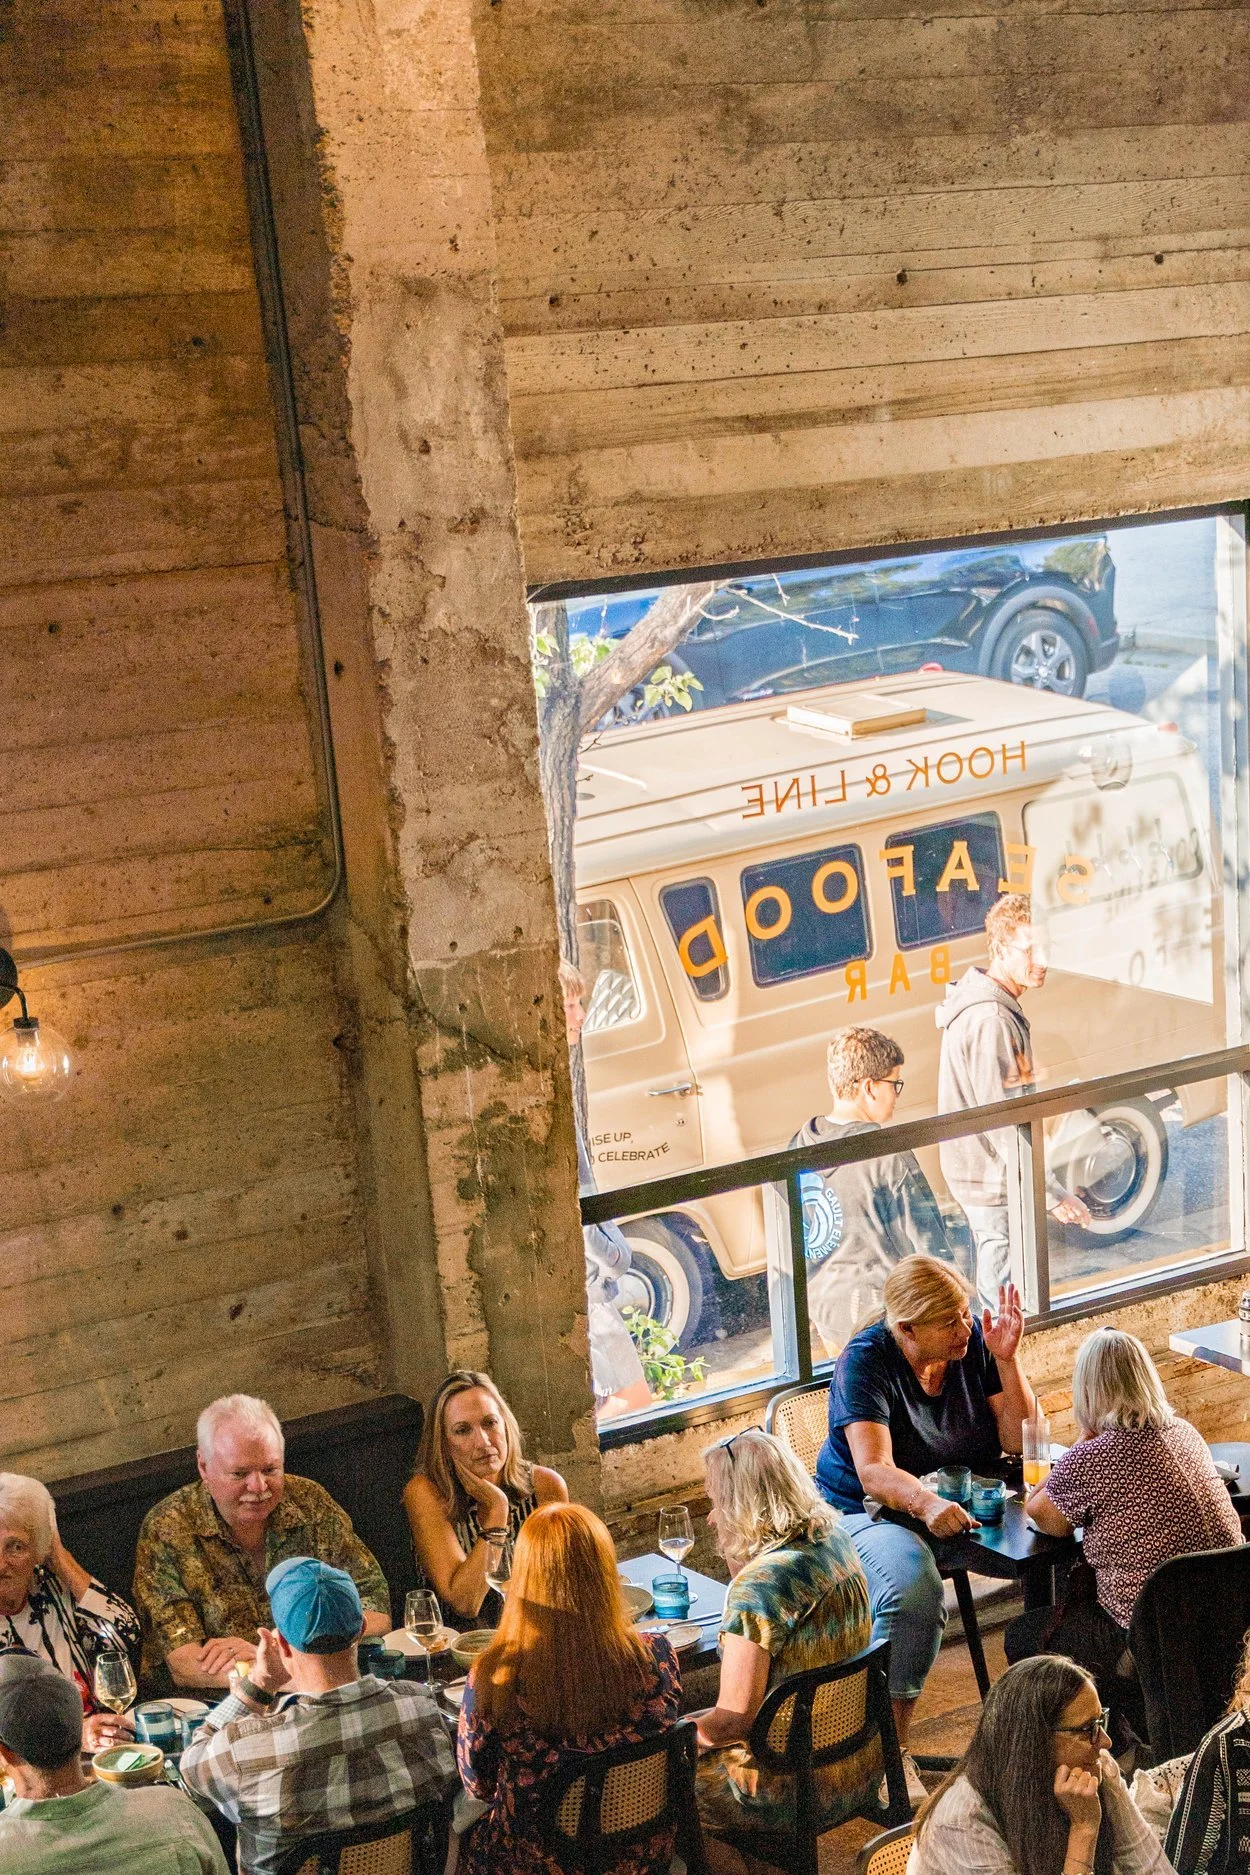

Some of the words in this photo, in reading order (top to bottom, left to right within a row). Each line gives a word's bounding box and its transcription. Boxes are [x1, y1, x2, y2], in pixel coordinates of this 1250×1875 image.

[591, 1133, 611, 1147] ISE
[613, 1132, 634, 1144] UP,
[598, 1142, 671, 1163] CELEBRATE
